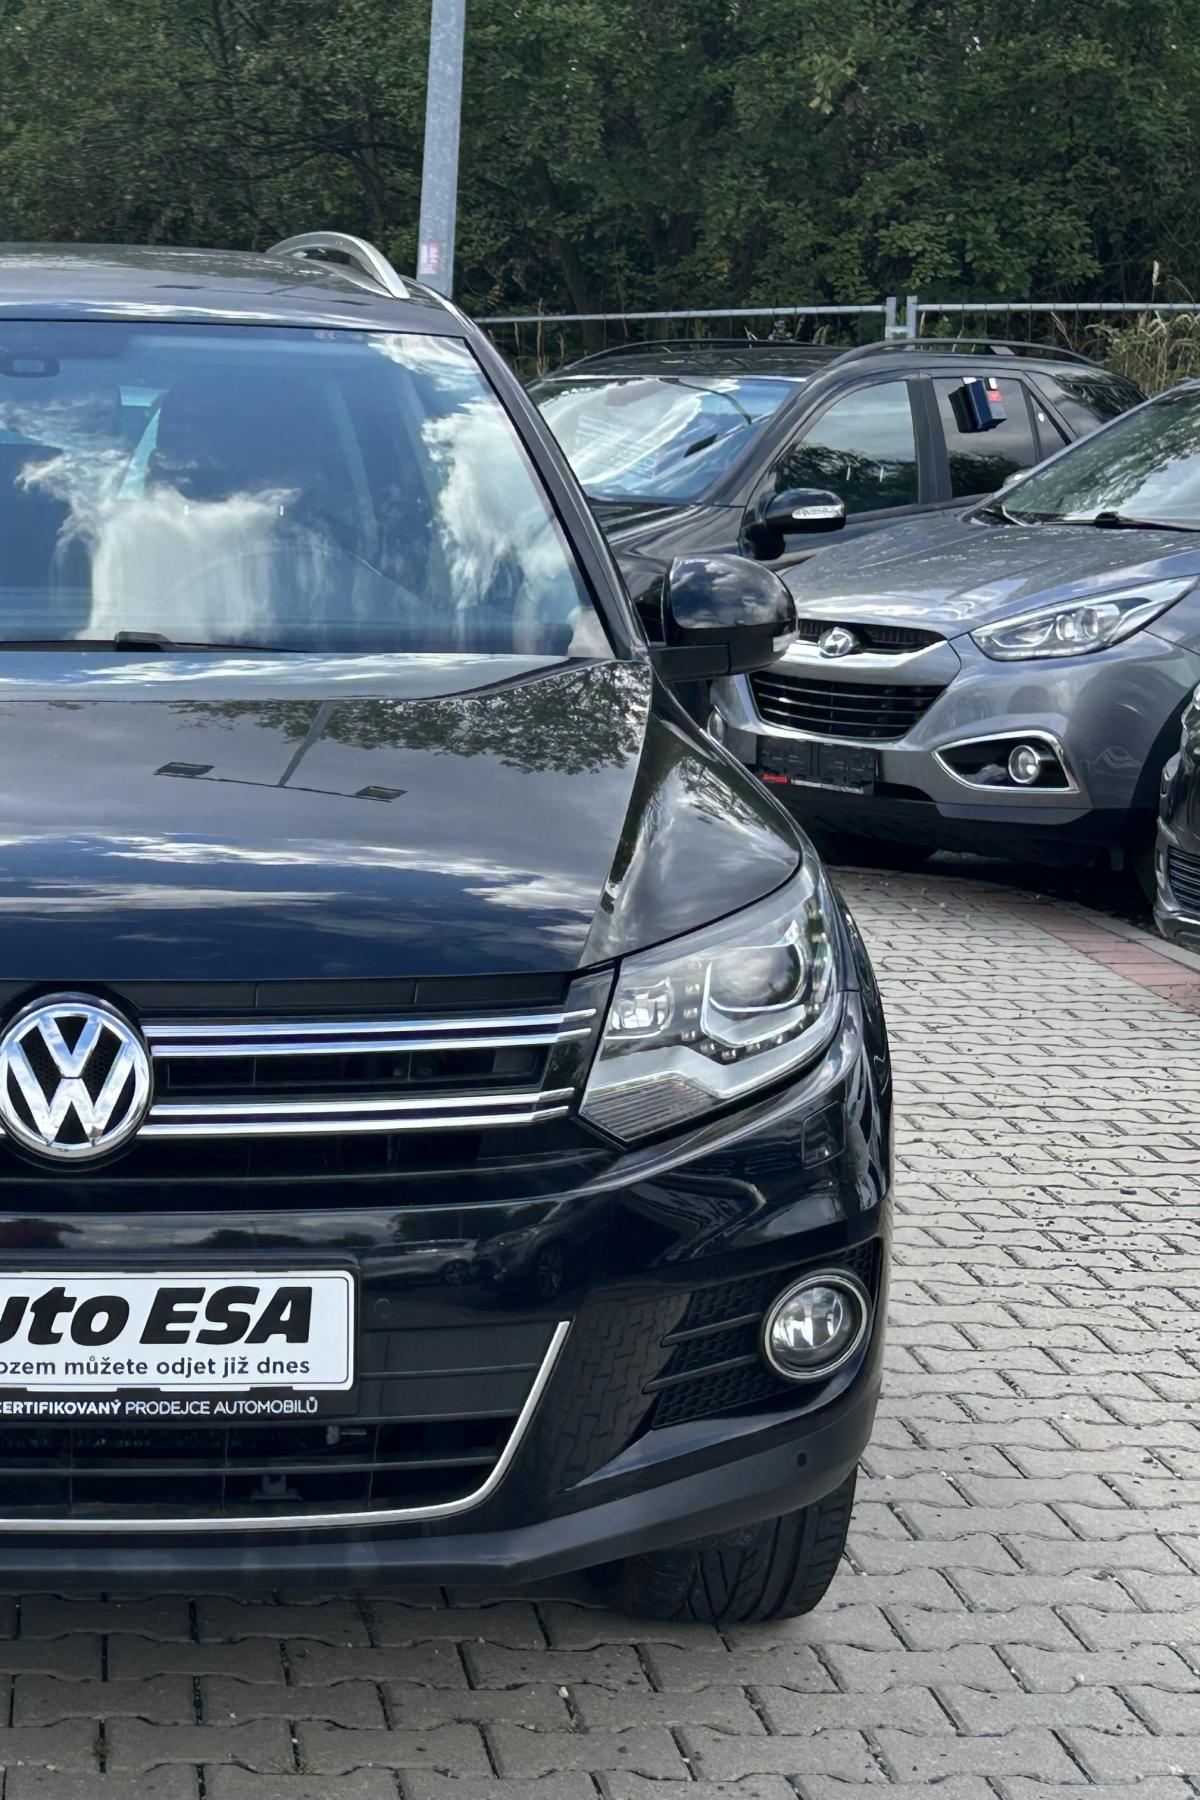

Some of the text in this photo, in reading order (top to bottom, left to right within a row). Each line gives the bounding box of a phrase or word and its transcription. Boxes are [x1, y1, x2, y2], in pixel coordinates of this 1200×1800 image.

[138, 1285, 313, 1346] ESA
[64, 1355, 149, 1376] můžete
[156, 1357, 216, 1378] odjet
[222, 1356, 250, 1378] již
[256, 1357, 311, 1374] dnes
[124, 1400, 211, 1415] PRODEJCE
[213, 1396, 319, 1415] AUTOMOBILŮ
